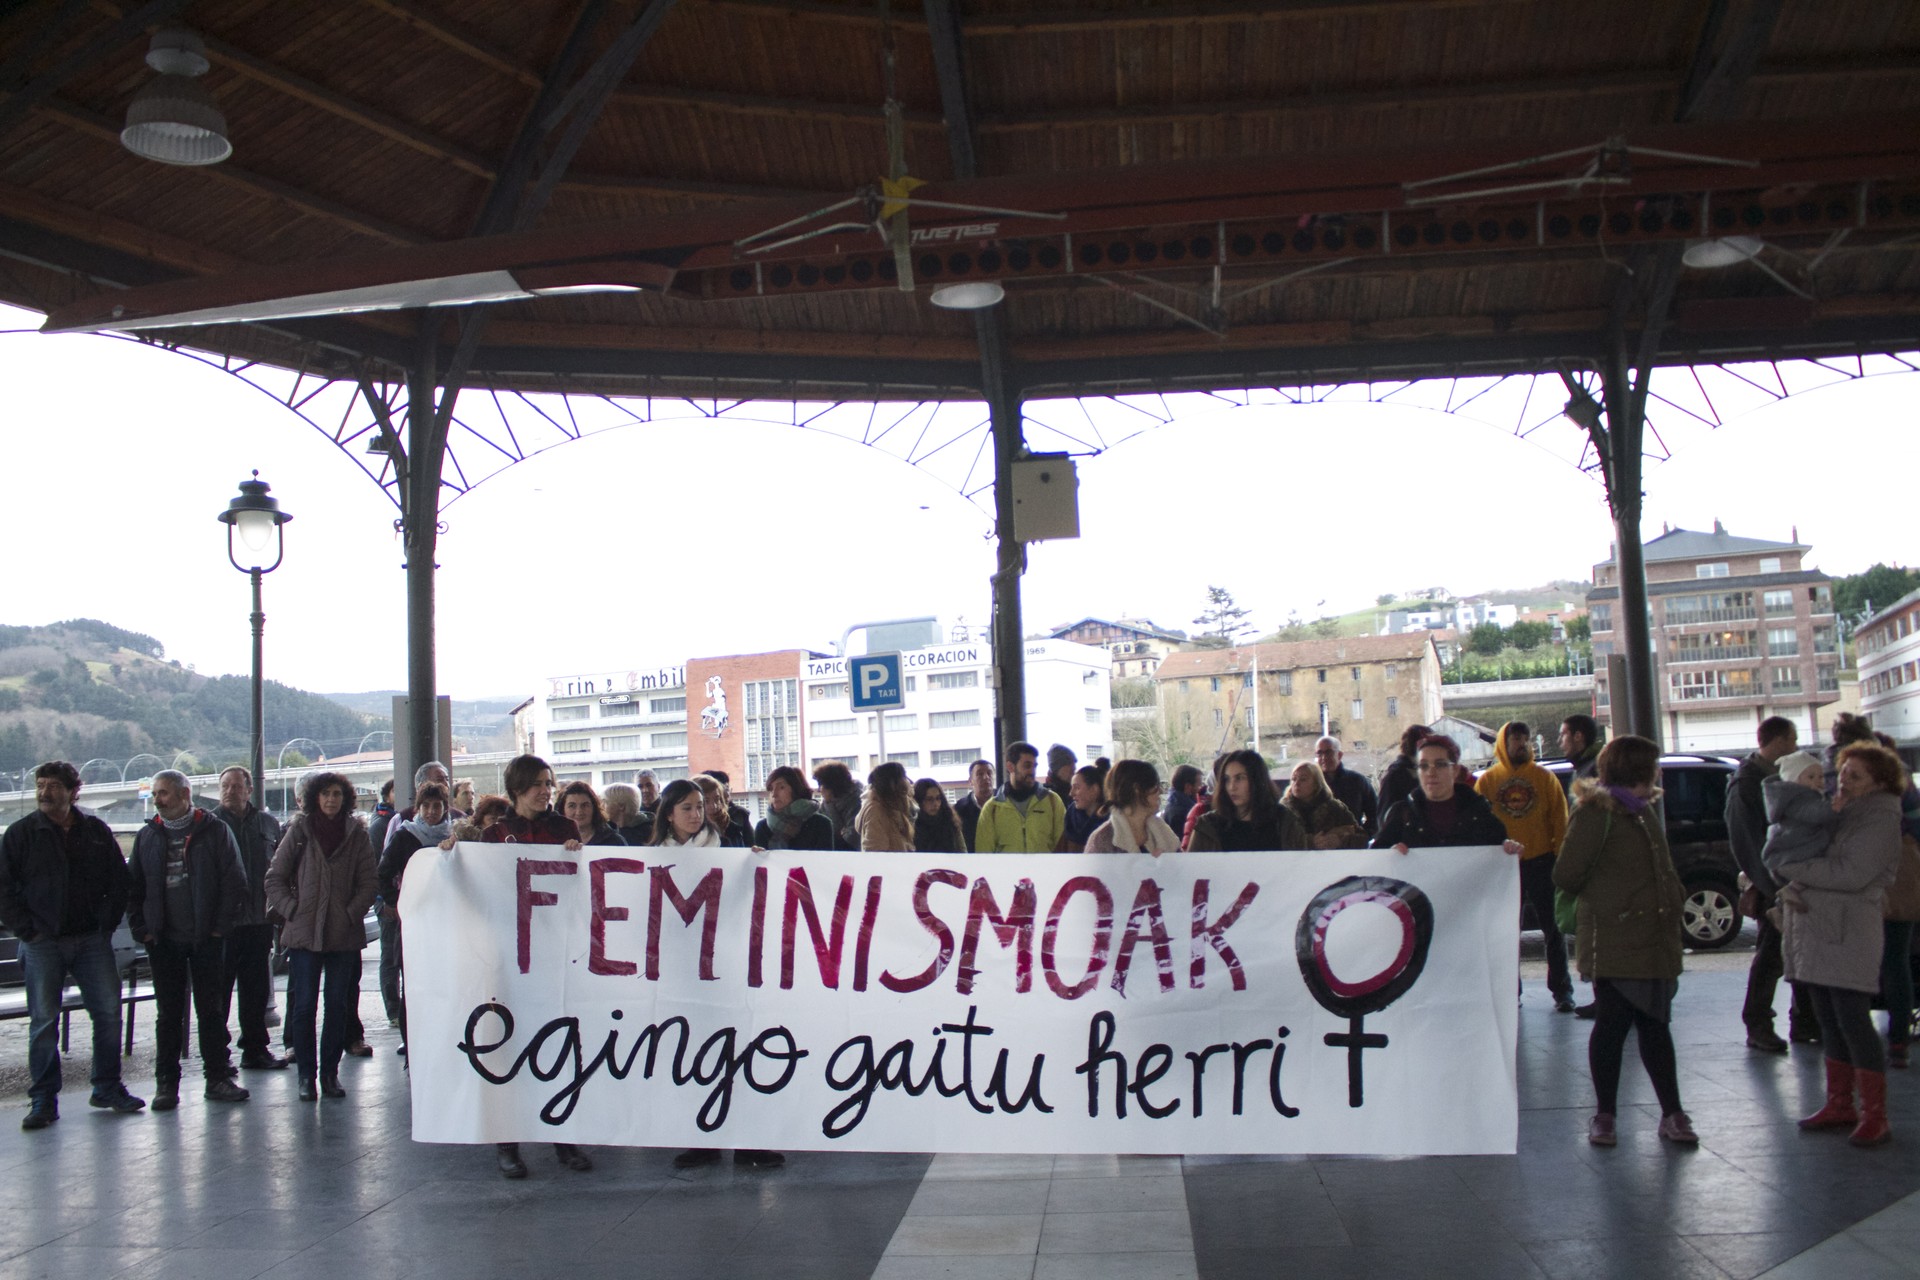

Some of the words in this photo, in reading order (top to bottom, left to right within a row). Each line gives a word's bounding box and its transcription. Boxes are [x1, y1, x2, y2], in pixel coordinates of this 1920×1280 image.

[1026, 646, 1046, 656] 1969
[860, 663, 890, 699] P
[878, 689, 897, 698] TAXI
[516, 856, 1260, 1000] FEMINISMOAK
[457, 1001, 809, 1133] egingo
[822, 1005, 1054, 1139] gaitu
[1076, 1010, 1300, 1119] herri
